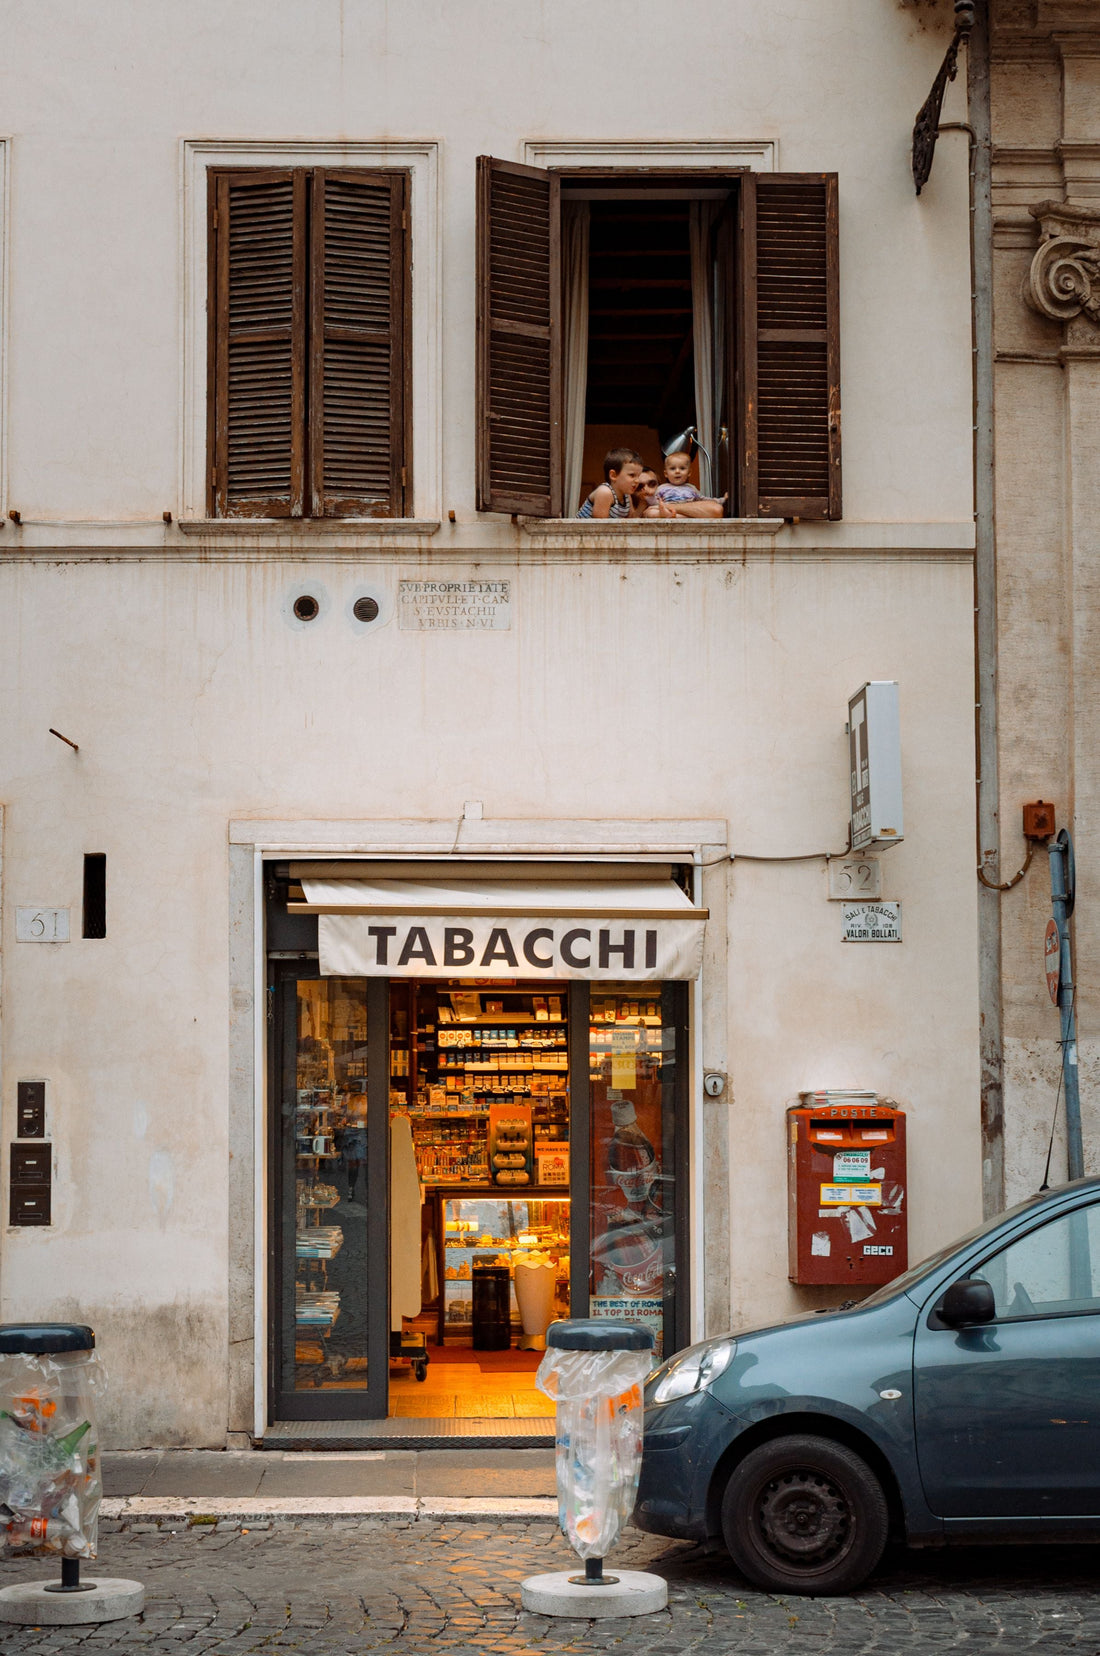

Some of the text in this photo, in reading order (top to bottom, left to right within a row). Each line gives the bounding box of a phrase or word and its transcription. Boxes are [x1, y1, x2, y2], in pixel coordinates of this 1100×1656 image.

[839, 865, 872, 891] 52
[845, 908, 861, 921] SALI
[867, 905, 898, 921] TABACCHI
[30, 912, 59, 938] 51
[846, 929, 898, 938] VALORI BOLLATI
[367, 925, 658, 970] TABACCHI
[830, 1108, 878, 1117] POSTE
[593, 1300, 608, 1308] THE
[609, 1300, 629, 1308] BEST
[604, 1309, 622, 1317] TOP
[636, 1309, 664, 1317] ROMA
